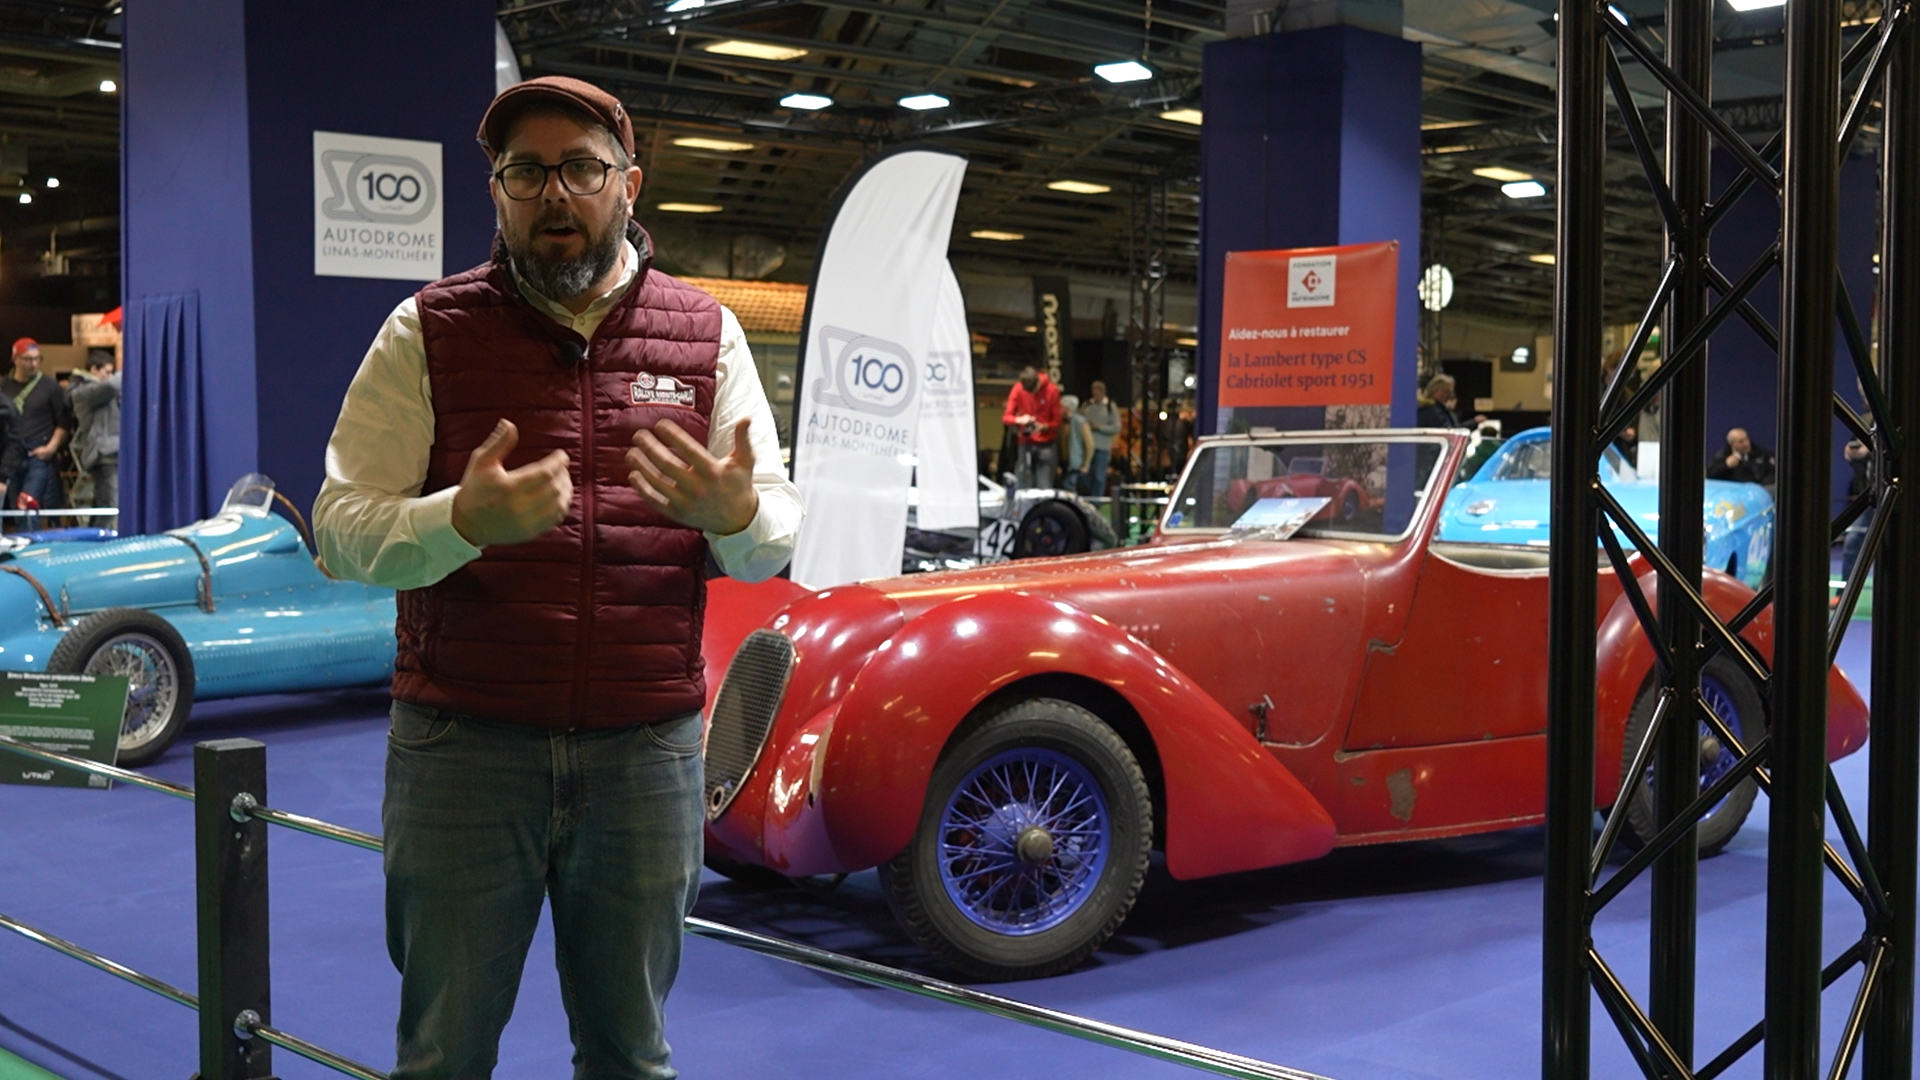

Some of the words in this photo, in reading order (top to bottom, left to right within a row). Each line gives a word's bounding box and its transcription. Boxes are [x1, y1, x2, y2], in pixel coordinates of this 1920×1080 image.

[362, 171, 421, 203] 100
[323, 227, 436, 248] AUTODROME
[1228, 328, 1288, 340] Aidez-nous
[1290, 325, 1297, 338] à
[1299, 326, 1350, 337] restaurer
[1228, 352, 1240, 368] la
[1244, 350, 1306, 367] Lambert
[1311, 351, 1343, 369] type
[1346, 348, 1367, 365] CS
[852, 354, 903, 393] 100
[1226, 373, 1293, 389] Cabriolet
[1296, 373, 1337, 391] sport
[1341, 373, 1374, 389] 1951
[808, 412, 909, 444] AUTODROME
[987, 521, 1016, 558] 42
